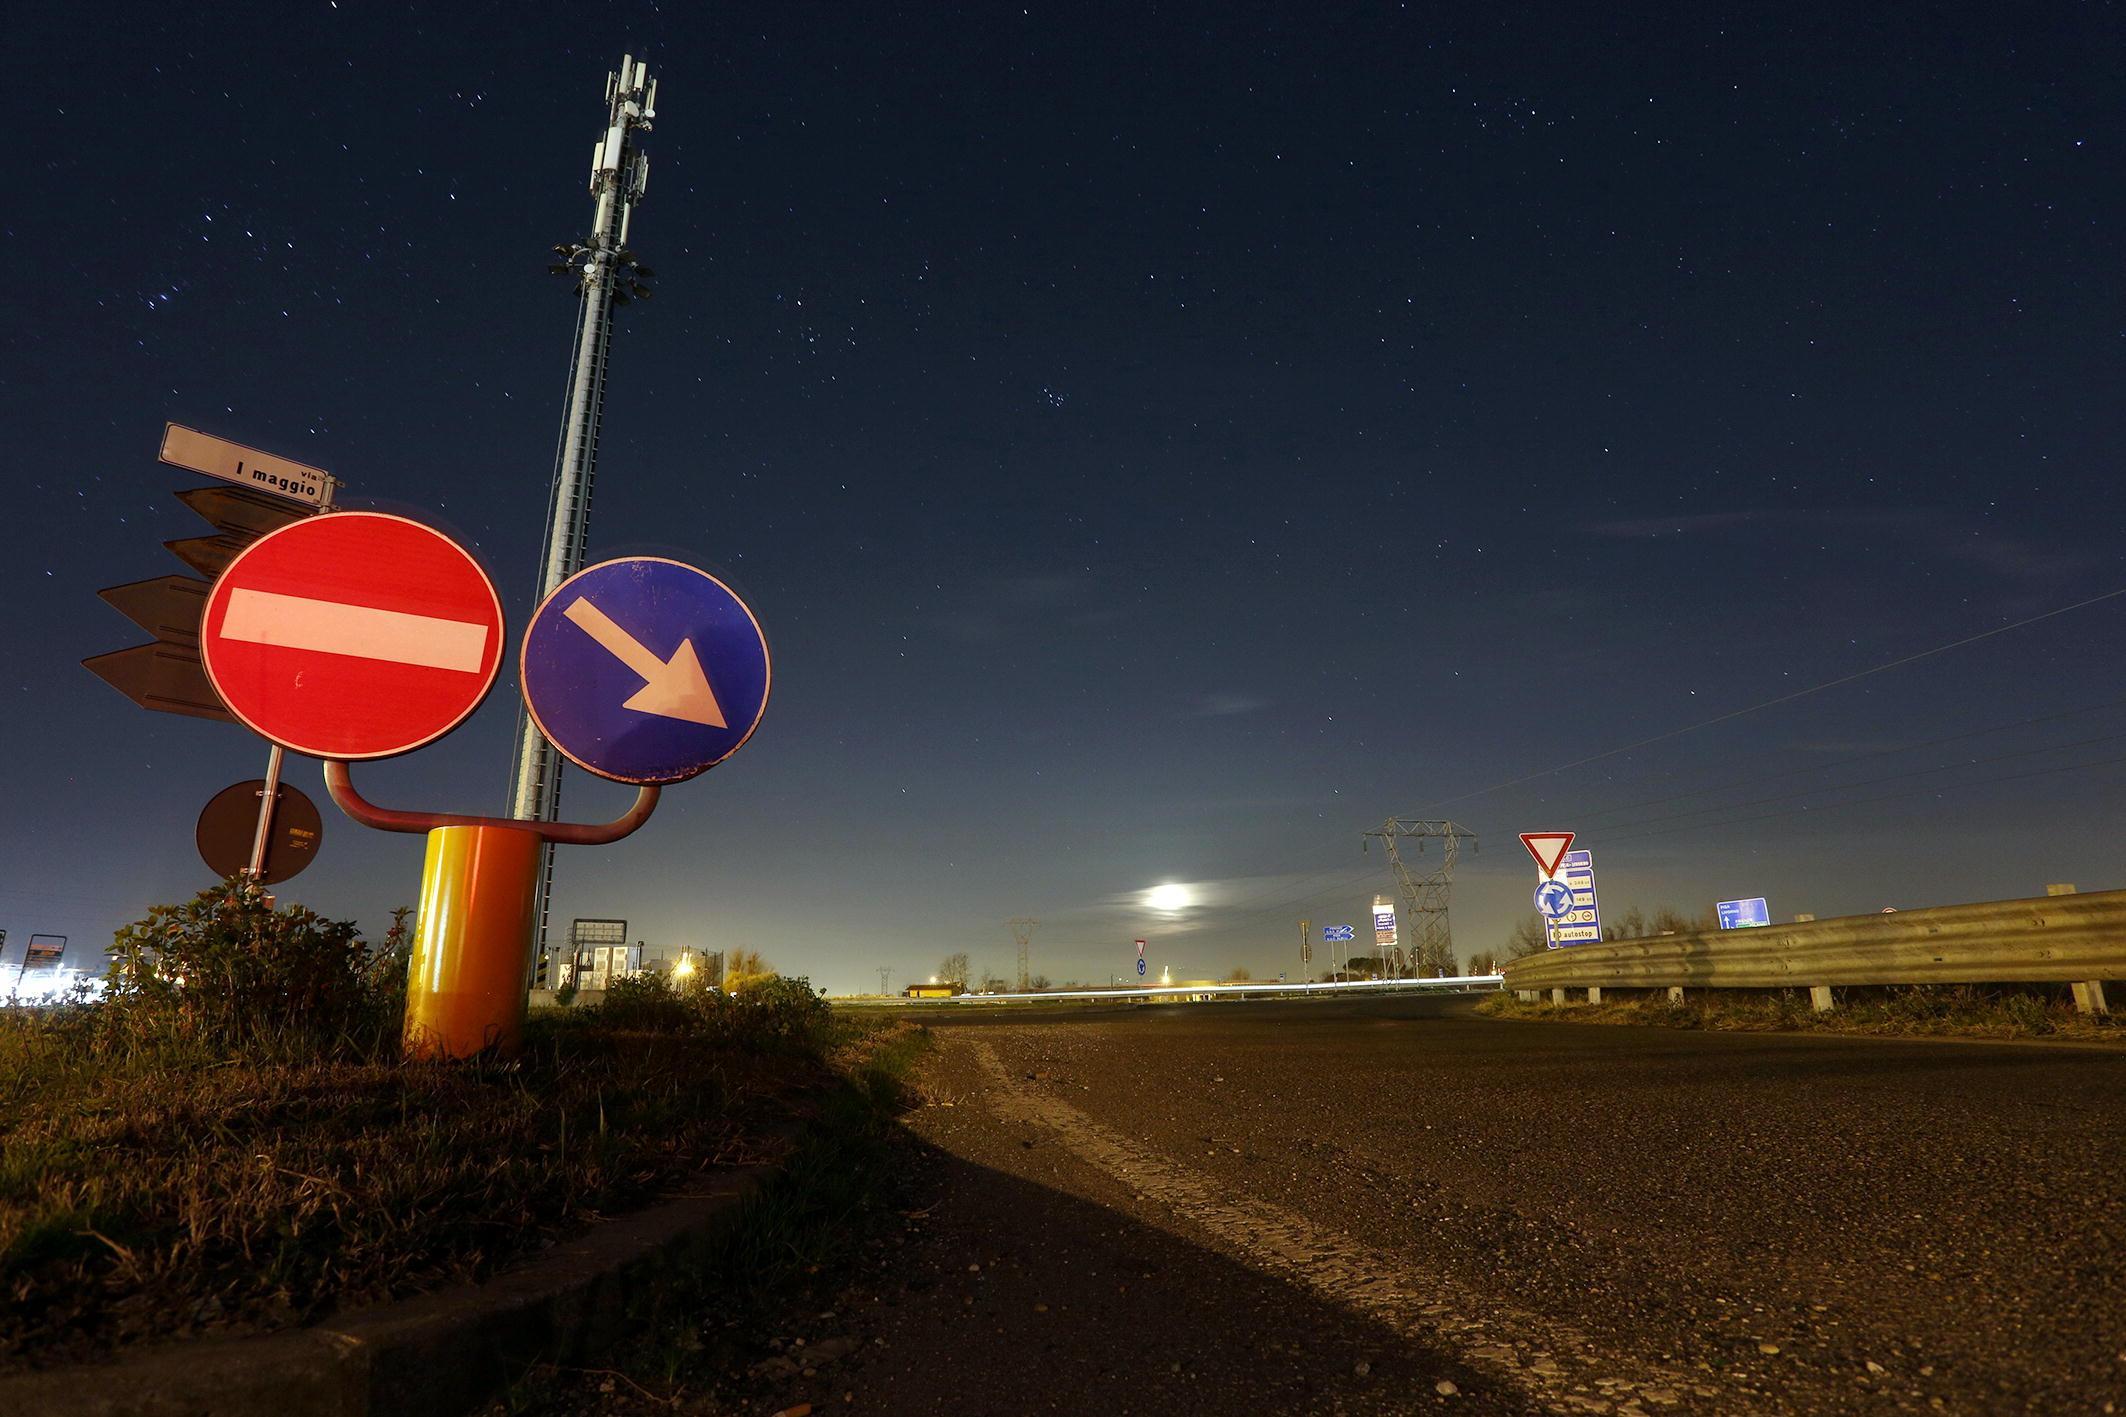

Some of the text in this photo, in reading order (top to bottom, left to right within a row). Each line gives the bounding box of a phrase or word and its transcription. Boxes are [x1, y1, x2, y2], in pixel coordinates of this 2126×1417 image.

[236, 461, 315, 496] I maggio
[301, 471, 317, 481] via
[1564, 930, 1592, 938] autostop
